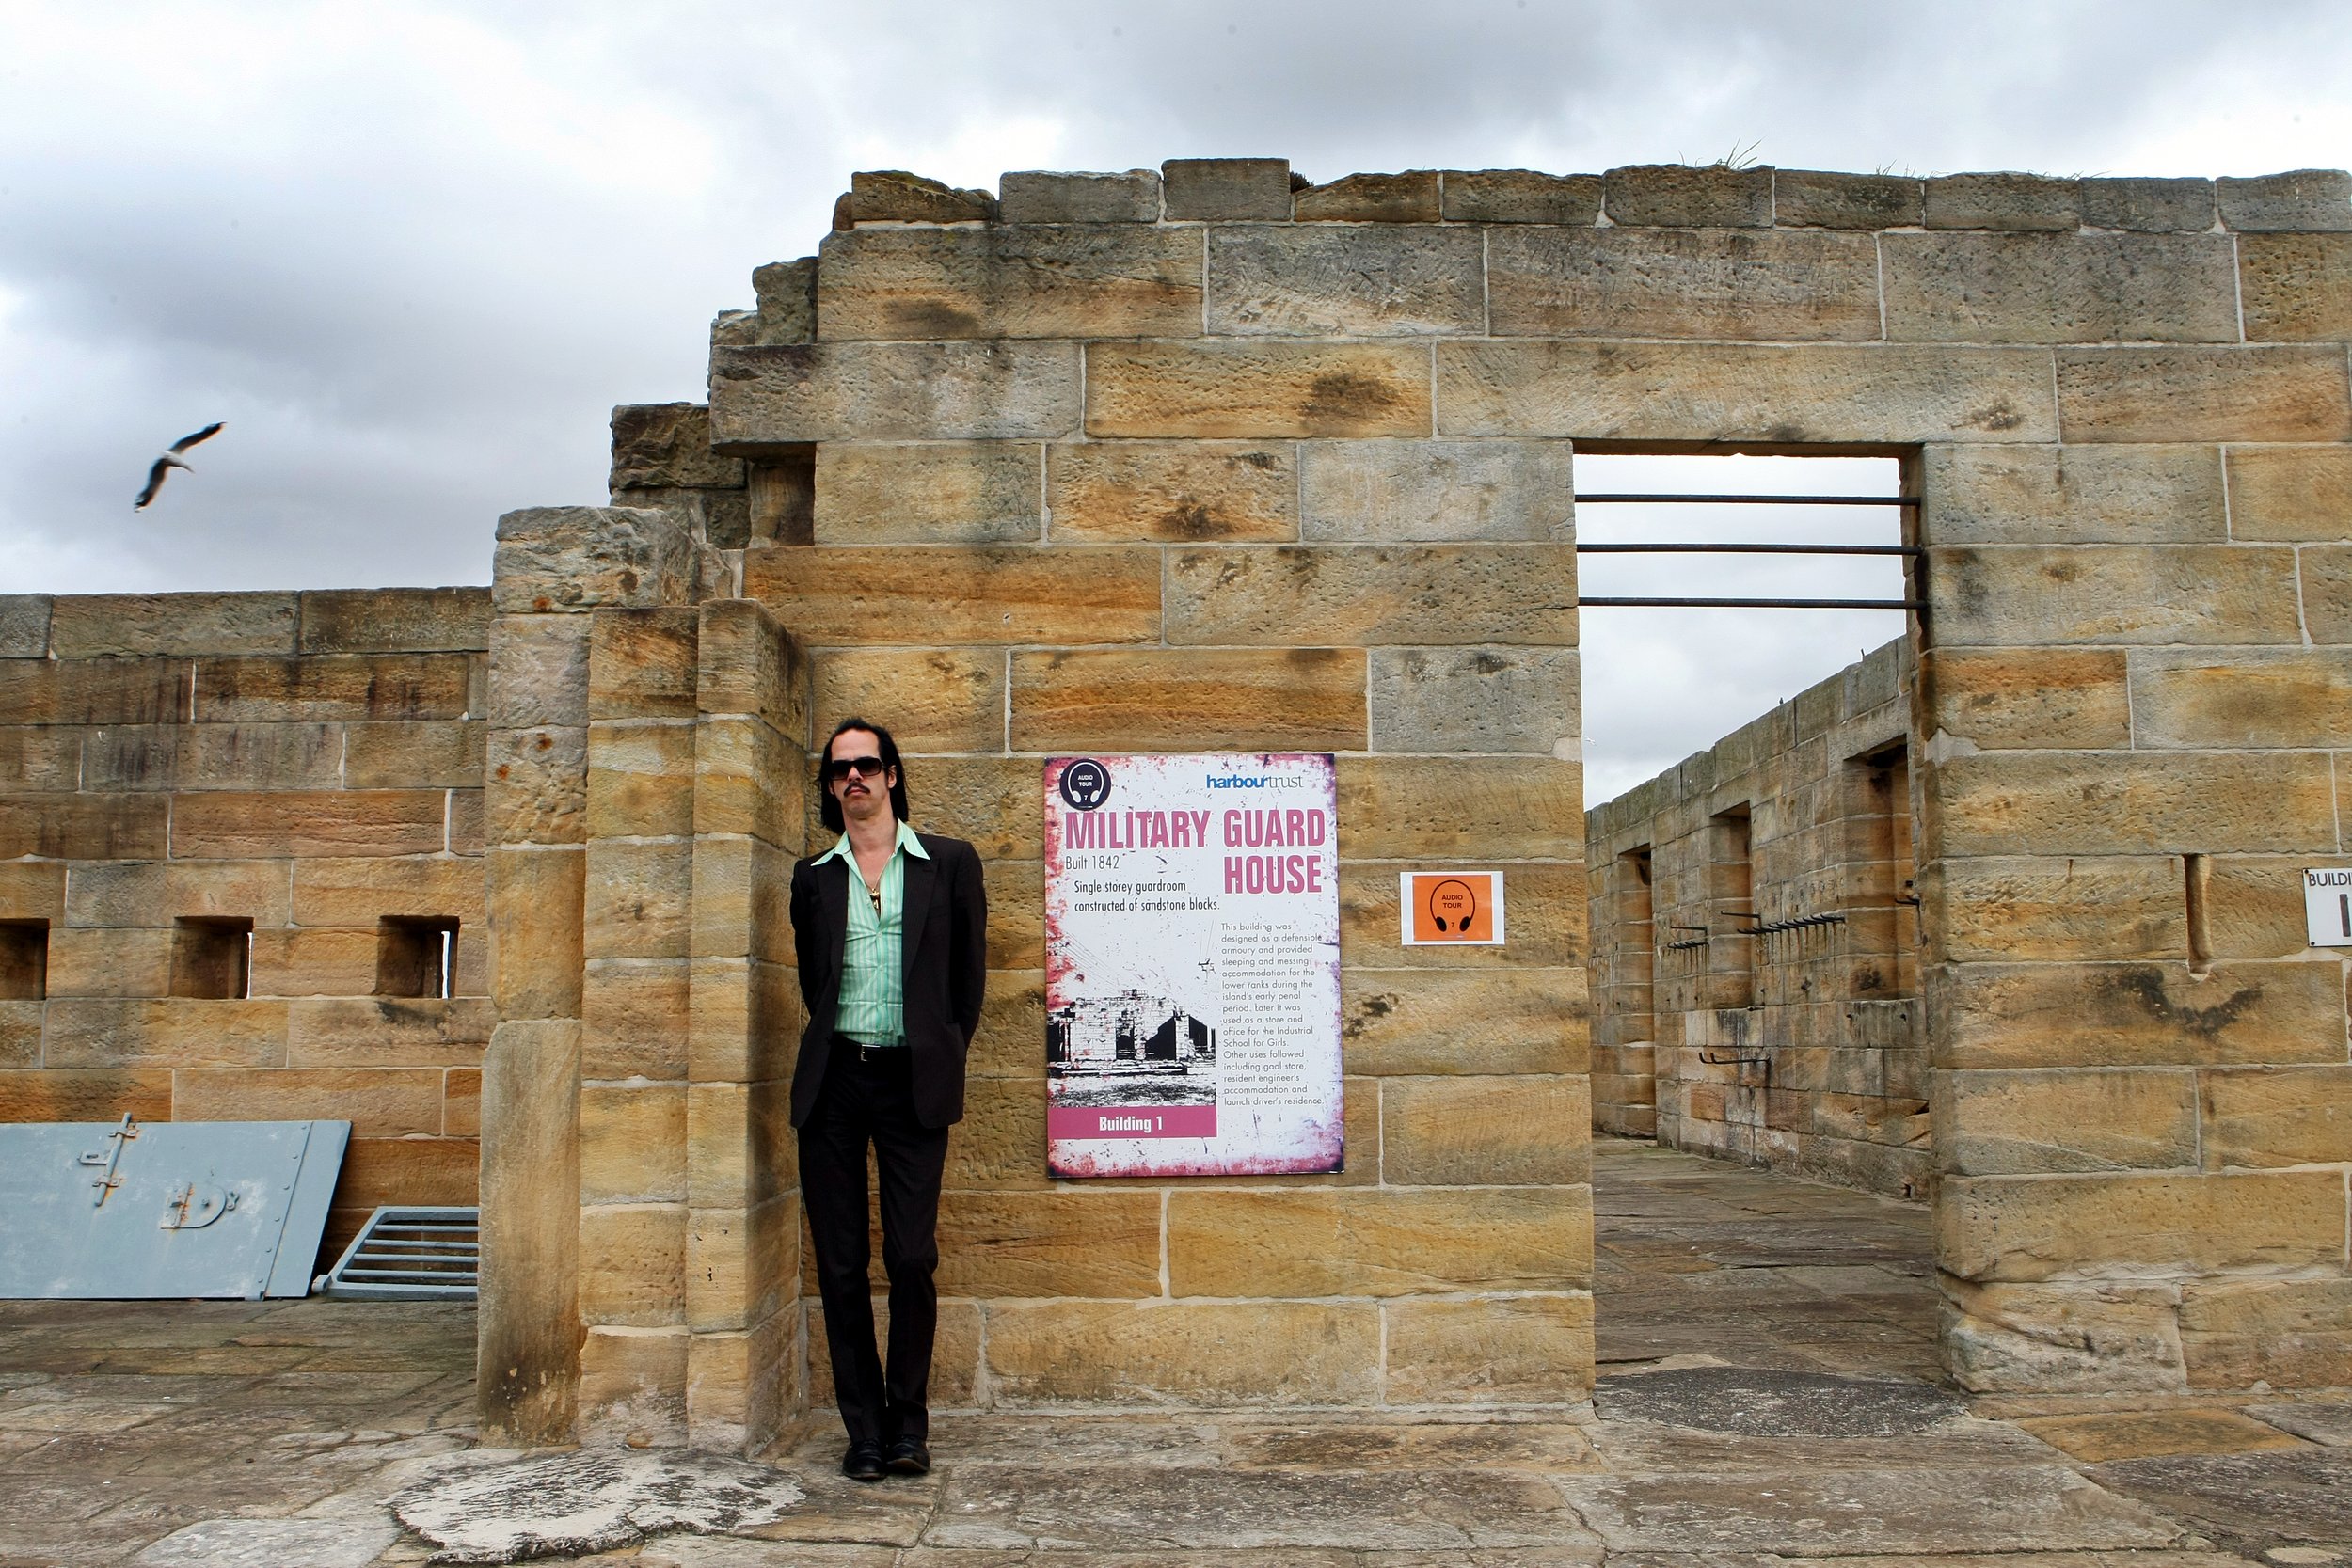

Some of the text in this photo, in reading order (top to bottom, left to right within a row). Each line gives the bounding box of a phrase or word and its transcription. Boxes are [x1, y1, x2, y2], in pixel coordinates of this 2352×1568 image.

[1065, 808, 1326, 849] MILITARY GUARD
[1066, 855, 1120, 870] Built 1842
[1224, 855, 1322, 894] HOUSE
[2309, 873, 2352, 886] BUILDI
[1074, 879, 1186, 895] Single storey guardroom
[1074, 897, 1220, 911] constructed of sandstone blocks.
[1221, 923, 1237, 931] This
[1240, 923, 1273, 932] building
[1221, 935, 1258, 944] designed
[1221, 958, 1255, 967] sleeping
[1259, 958, 1274, 966] and
[1222, 970, 1286, 978] accommodation
[1272, 980, 1298, 990] during
[1255, 992, 1276, 1001] early
[1279, 991, 1301, 1001] penal
[1223, 1004, 1252, 1012] period.
[1255, 1004, 1274, 1012] Later
[1223, 1027, 1246, 1036] office
[1277, 1026, 1313, 1035] Industrial
[1267, 1038, 1289, 1047] Girls.
[1224, 1051, 1247, 1059] Other
[1270, 1050, 1304, 1058] followed
[1224, 1062, 1307, 1072] including gaol store,
[1224, 1074, 1300, 1084] resident engineer's
[1224, 1085, 1308, 1095] accommodation and
[1224, 1098, 1250, 1106] launch
[1284, 1097, 1324, 1105] residence.
[1099, 1116, 1163, 1133] Building 1
